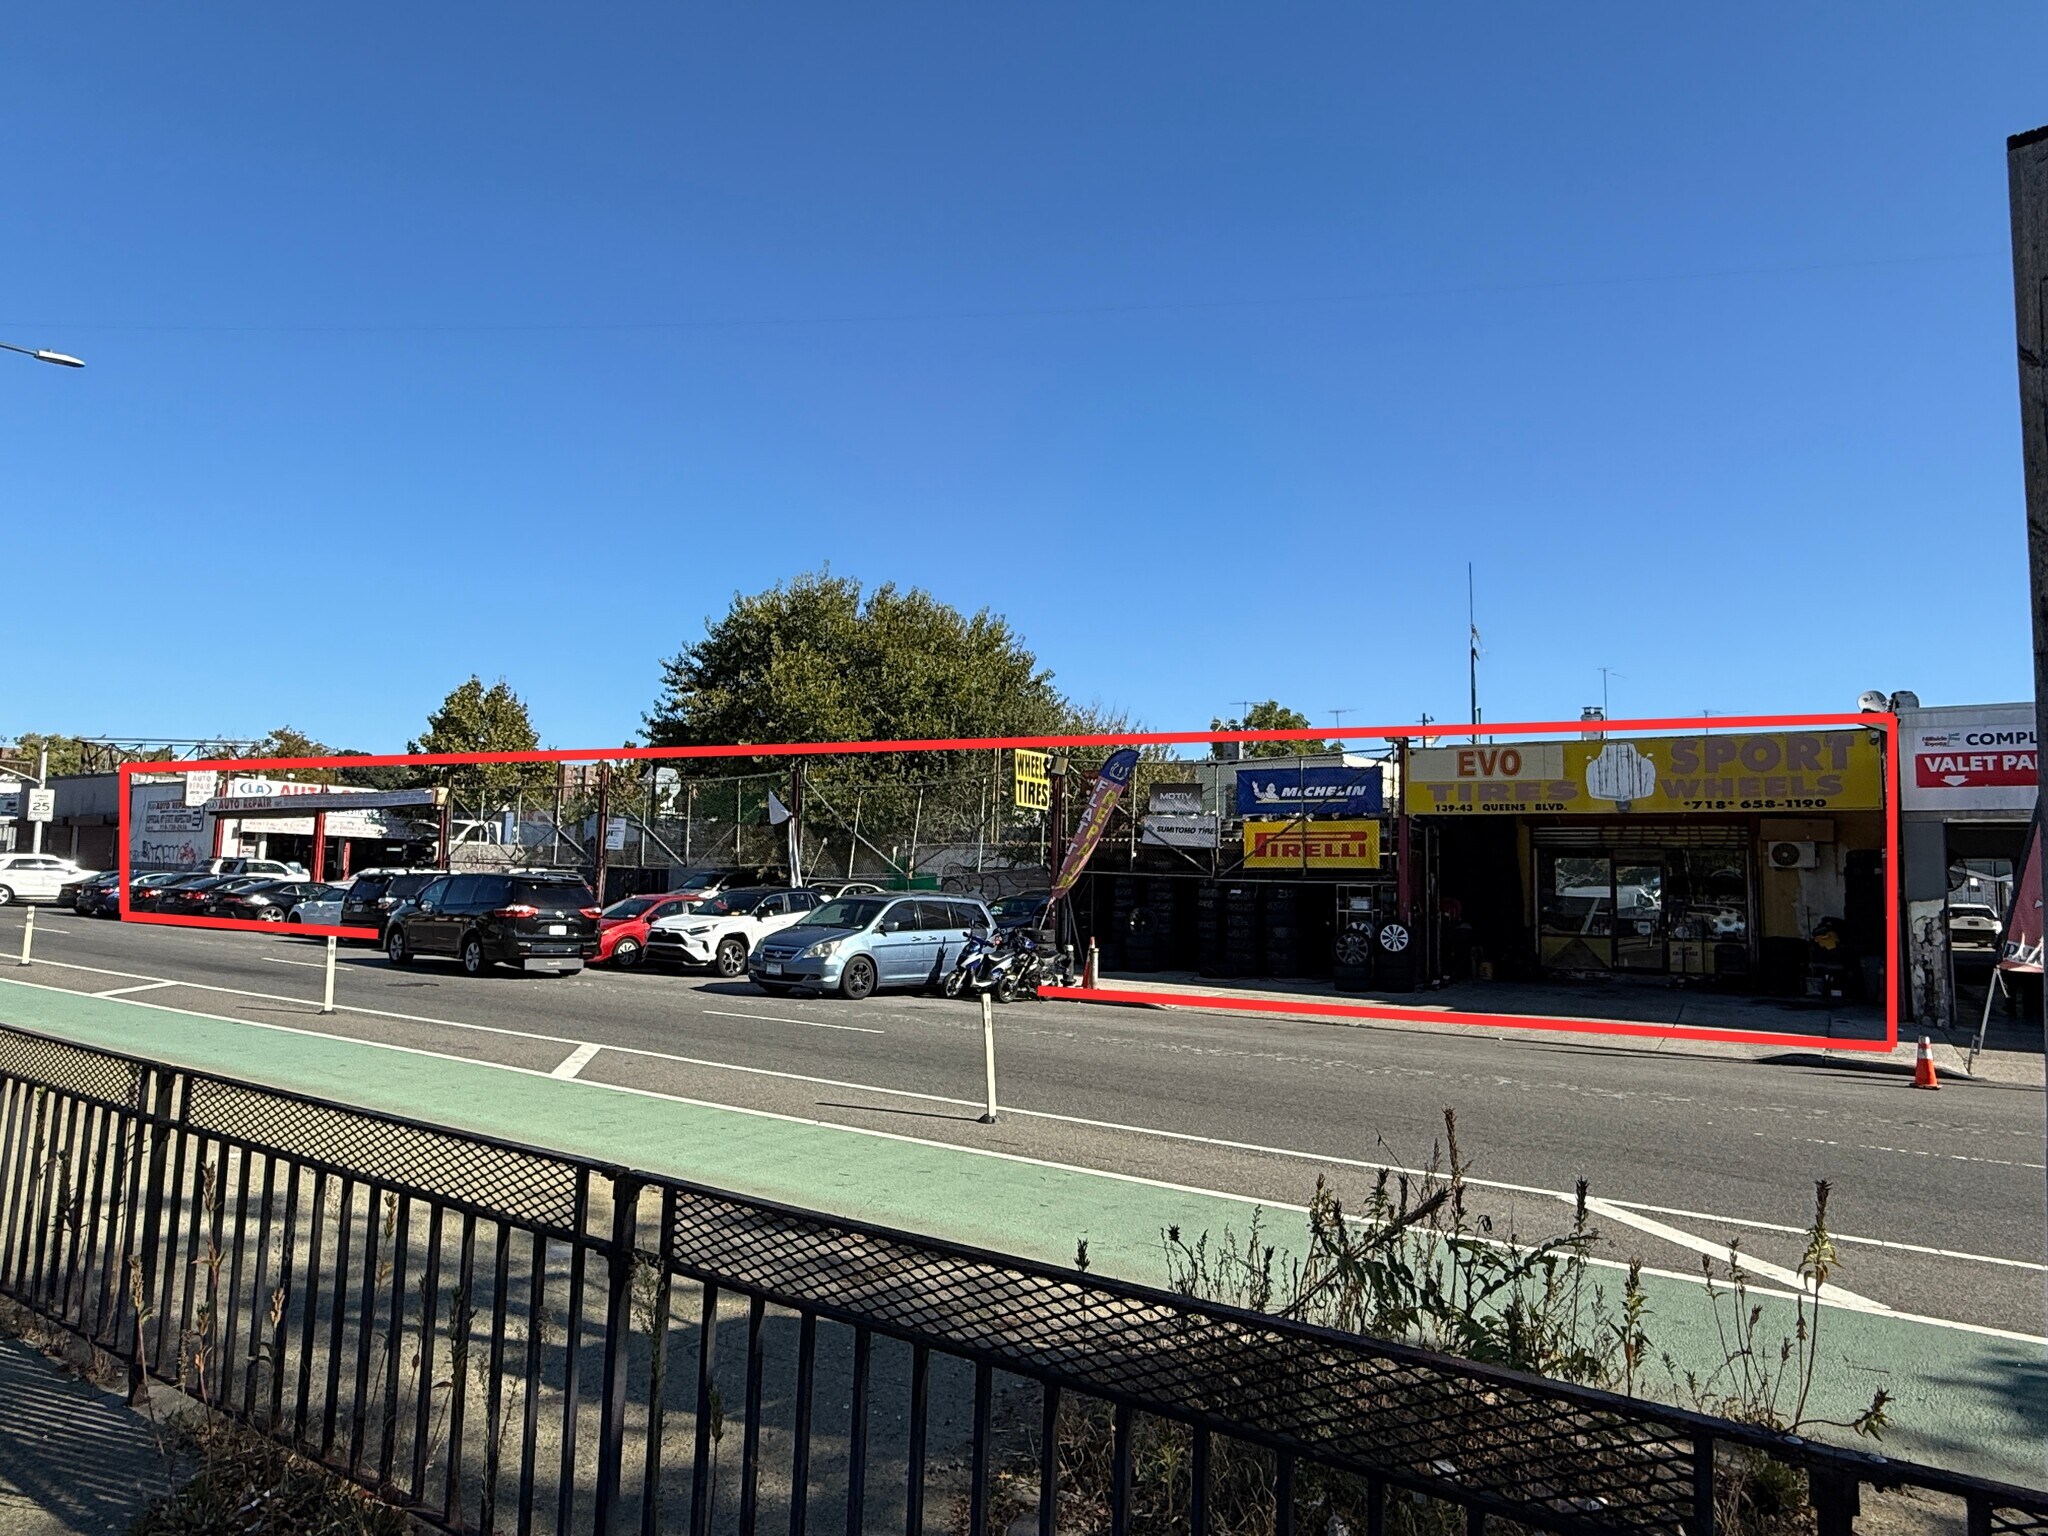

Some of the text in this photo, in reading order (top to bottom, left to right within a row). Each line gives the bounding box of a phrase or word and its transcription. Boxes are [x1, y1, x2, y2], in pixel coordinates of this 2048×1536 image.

[1457, 749, 1522, 778] EVO
[1670, 733, 1854, 774] SPORT
[1924, 755, 1997, 772] VALET
[1016, 753, 1050, 780] WHEELS
[1016, 779, 1048, 806] TIRES
[1281, 785, 1366, 798] MICHELIN
[1427, 781, 1578, 802] TIRES
[1661, 775, 1843, 799] WHEELS
[32, 802, 50, 811] 25
[219, 799, 240, 809] AUTO
[243, 798, 272, 809] REPAIR
[1080, 779, 1109, 834] FLAT
[1435, 803, 1567, 812] 139-43 QUEENS BLVD.
[1740, 799, 1827, 809] 658-1190
[1157, 825, 1197, 834] SUMITOMO
[1254, 832, 1368, 858] PIRELLI
